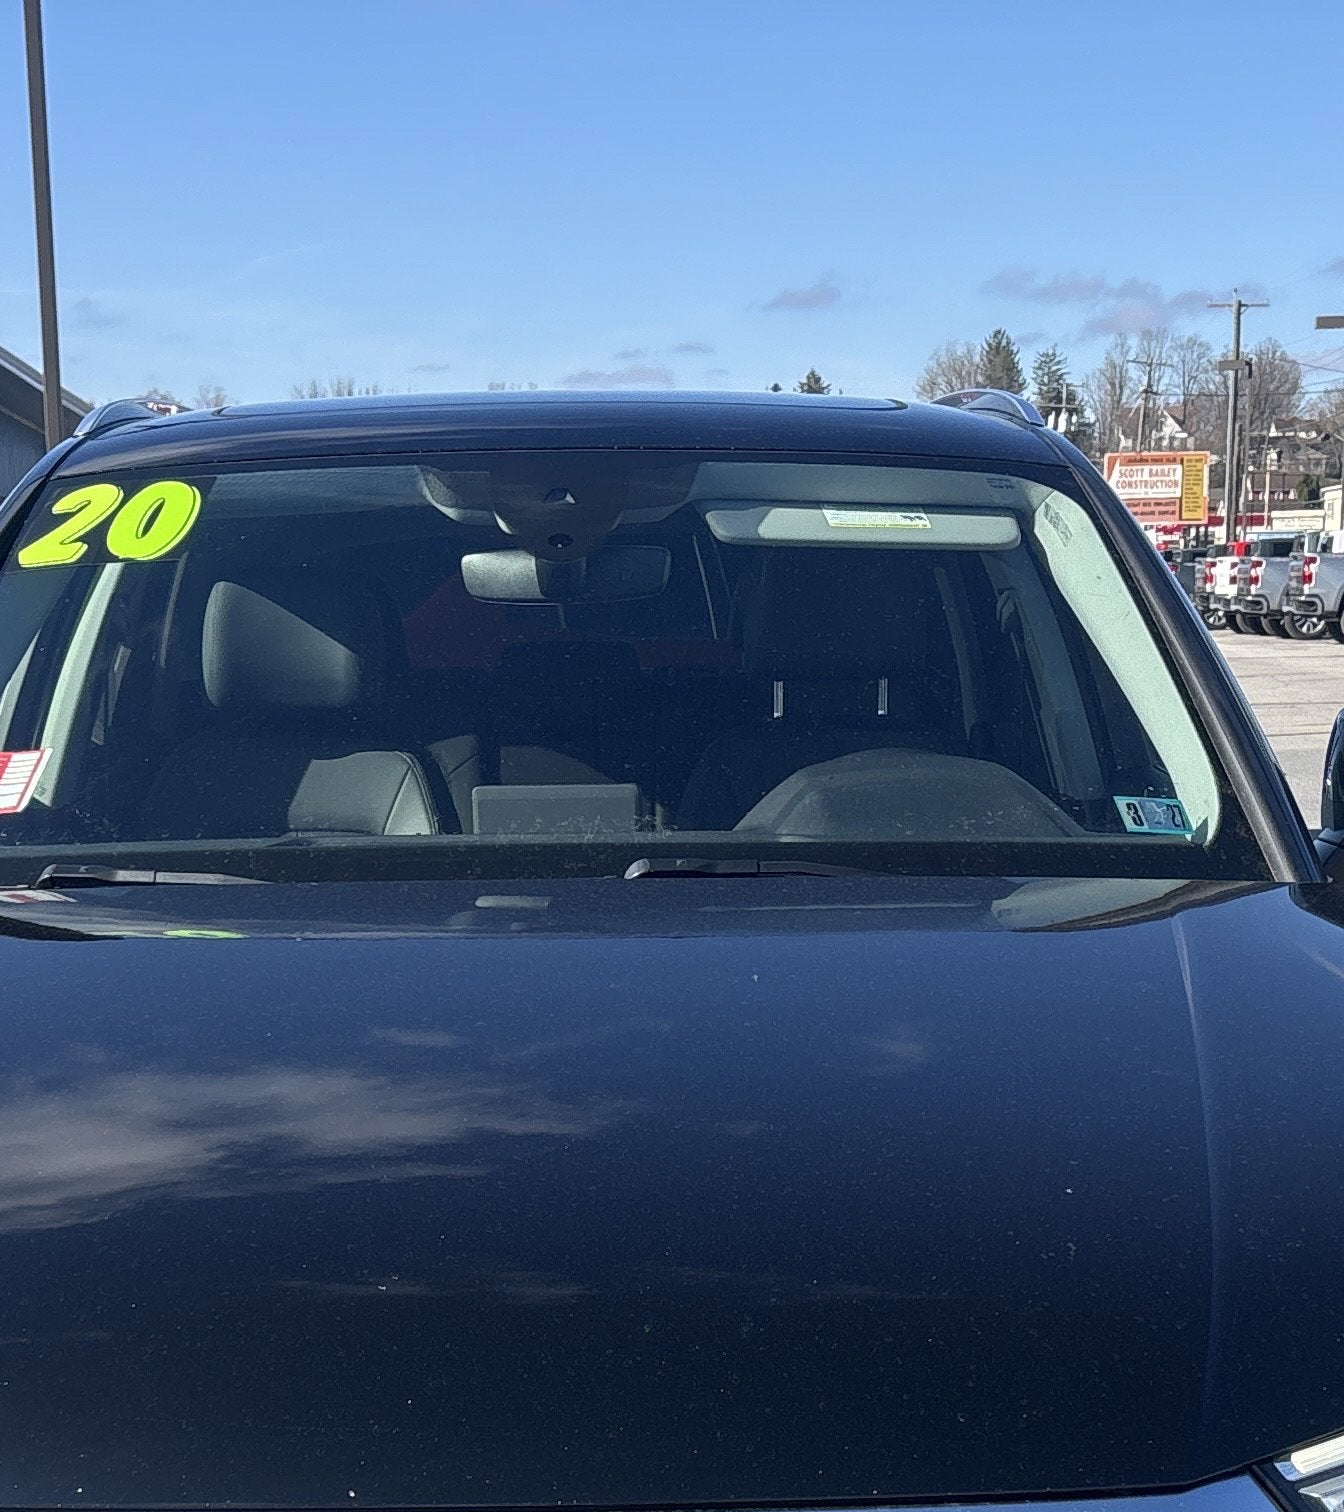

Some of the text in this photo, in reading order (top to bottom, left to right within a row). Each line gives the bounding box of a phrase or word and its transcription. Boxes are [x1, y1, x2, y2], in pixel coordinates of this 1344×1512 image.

[1118, 466, 1178, 479] SCOTT BAILEY
[1116, 479, 1180, 490] CONSTRUCTION
[18, 480, 201, 568] 20
[1125, 802, 1145, 827] 3
